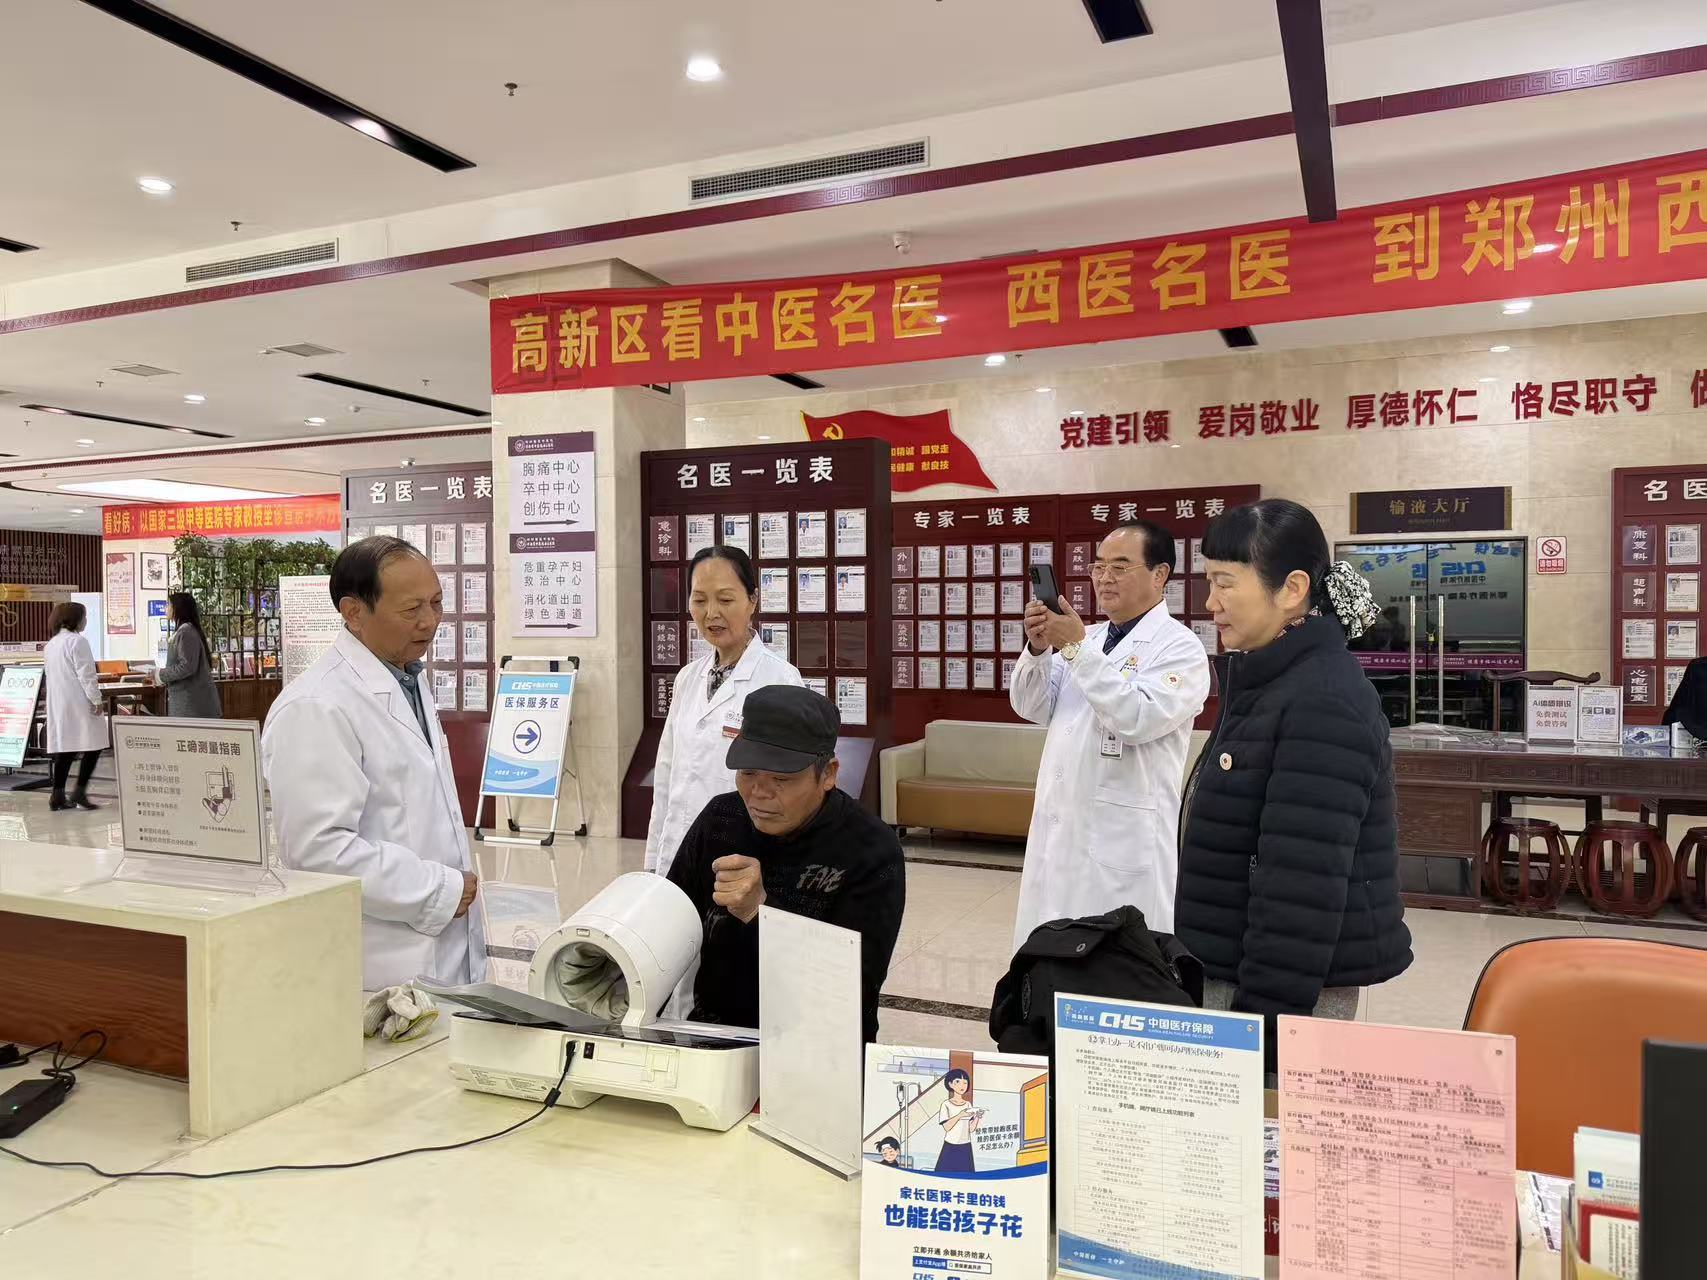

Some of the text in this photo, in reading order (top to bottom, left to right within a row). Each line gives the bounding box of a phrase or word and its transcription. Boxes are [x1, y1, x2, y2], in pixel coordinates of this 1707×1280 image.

[510, 274, 944, 374] 高新区看中医名医
[1007, 228, 1292, 328] 西医名医
[1060, 410, 1171, 450] 党建引领
[1198, 398, 1319, 439] 爱岗敬业
[1347, 387, 1478, 430] 厚德怀仁
[1511, 373, 1657, 421] 恪尽职守
[523, 460, 580, 476] 胸痛中心
[677, 456, 833, 489] 名医一览表
[369, 475, 493, 504] 名医一览表
[523, 480, 580, 495] 卒中中心
[524, 500, 580, 516] 创伤中心
[1091, 498, 1225, 523] 专家一览表
[1390, 497, 1470, 515] 输液大厅
[913, 507, 1031, 529] 专家一览表
[524, 561, 582, 572] 危重孕产妇
[524, 575, 582, 586] 救治中心
[524, 594, 582, 605] 消化道出血
[524, 608, 582, 620] 绿色通道
[504, 697, 560, 709] 医保服务区
[176, 740, 241, 756] 正确测量指南
[1099, 1011, 1145, 1032] CHS
[1148, 1017, 1214, 1035] 中国医疗保障
[900, 1186, 1006, 1208] 家长医保卡里的钱
[884, 1204, 1023, 1238] 也能给孩子花
[913, 1246, 992, 1260] 立即开通 余额共济给家人
